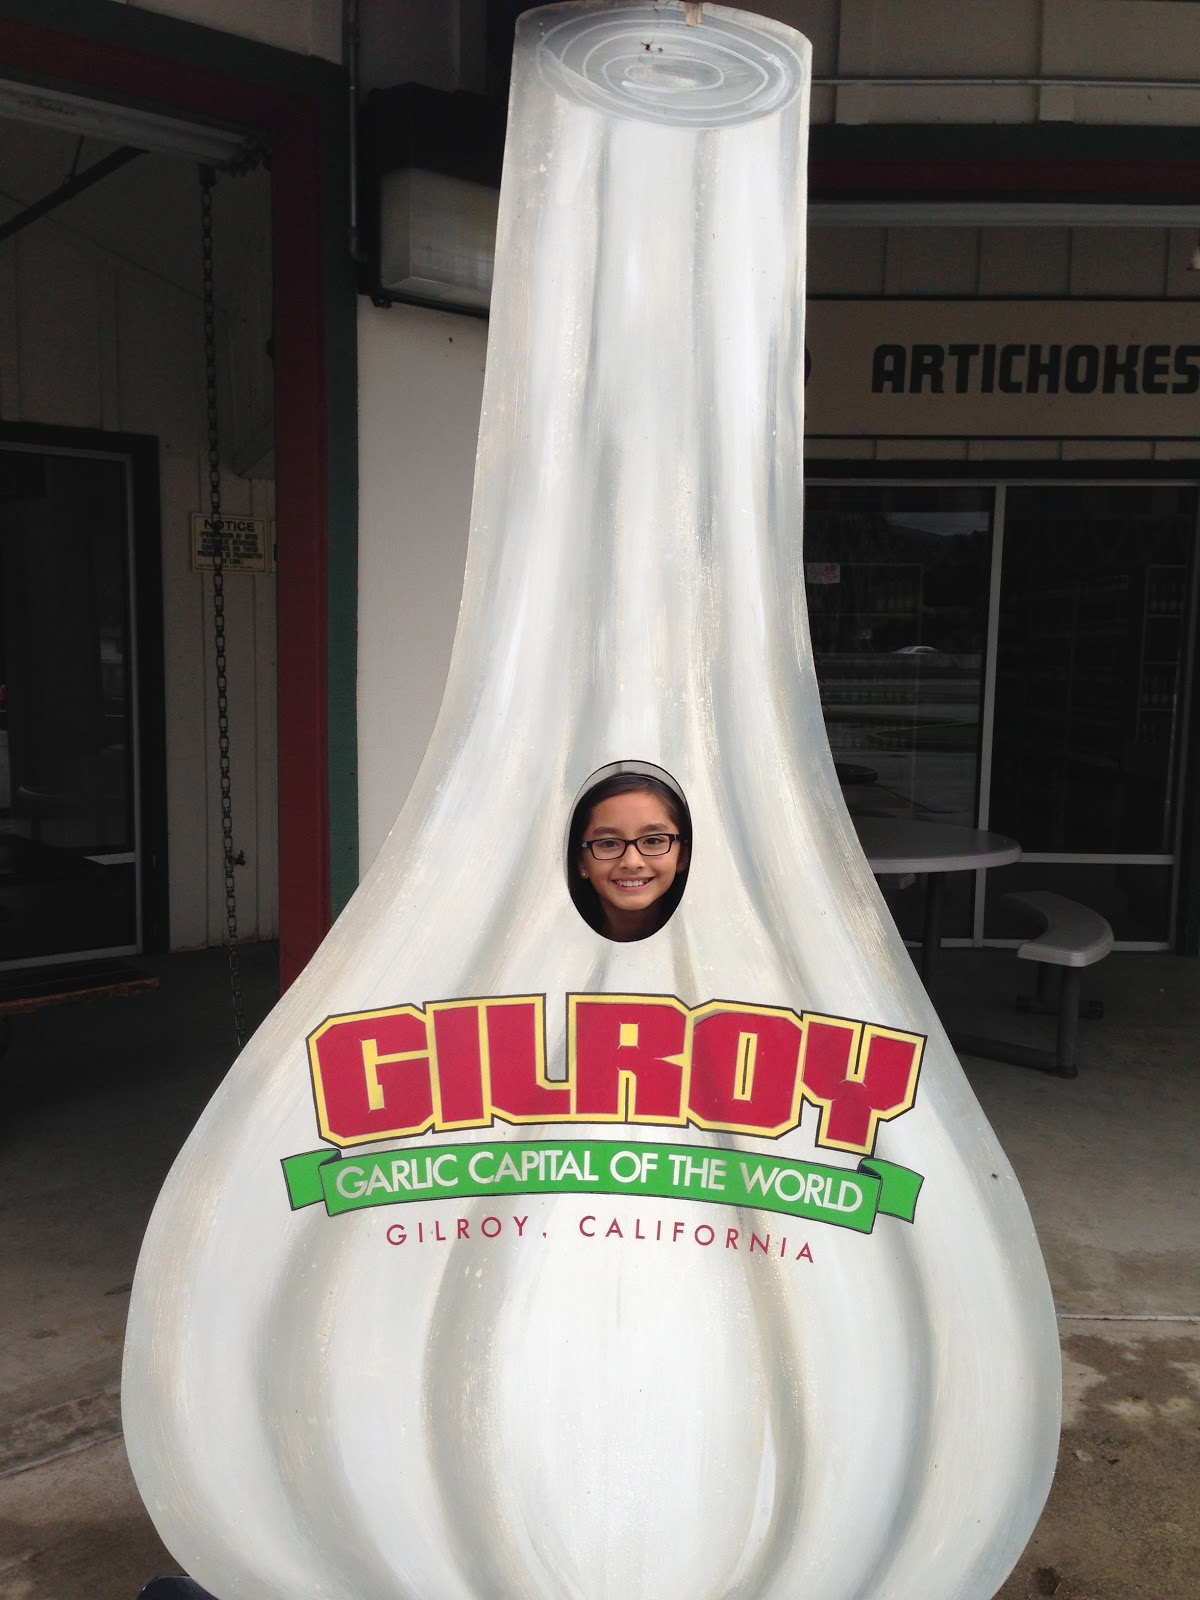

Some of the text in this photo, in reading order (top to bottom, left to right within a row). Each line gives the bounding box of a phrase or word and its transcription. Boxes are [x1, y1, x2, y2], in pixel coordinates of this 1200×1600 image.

[871, 344, 1200, 394] ARTICHOKES
[204, 519, 255, 532] NOTICE
[305, 991, 928, 1156] GILROY
[336, 1150, 863, 1213] GARLIC CAPITAL OF THE WORLD
[386, 1215, 814, 1264] GILROY, CALIFORNIA
